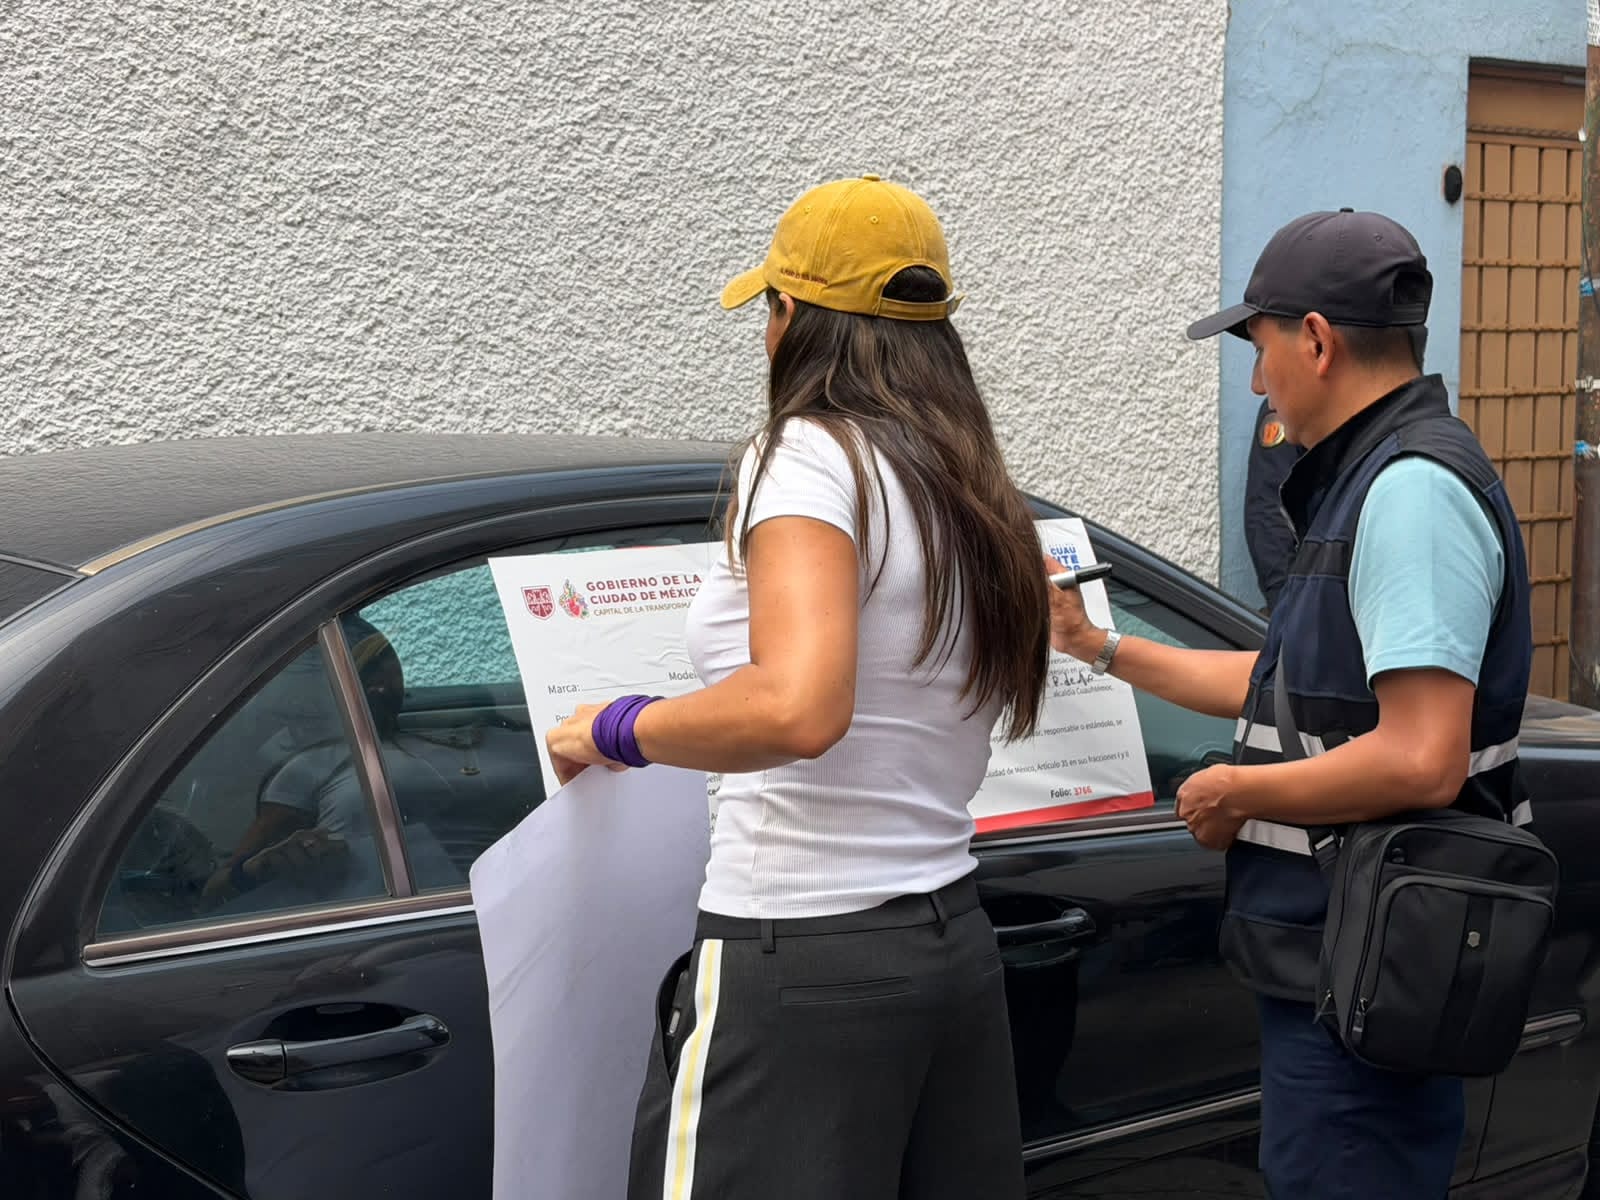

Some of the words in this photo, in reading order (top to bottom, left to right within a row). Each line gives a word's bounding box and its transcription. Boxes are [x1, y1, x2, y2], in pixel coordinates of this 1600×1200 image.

[1050, 546, 1076, 555] CUAU
[586, 577, 658, 592] GOBIERNO
[662, 575, 681, 586] DE
[684, 573, 702, 584] LA
[590, 592, 637, 605] CIUDAD
[640, 590, 657, 601] DE
[594, 607, 622, 617] CAPITAL
[623, 606, 634, 615] DE
[635, 605, 645, 613] LA
[548, 684, 581, 695] Marca:
[1044, 723, 1080, 736] responsable
[1069, 759, 1077, 767] en
[1051, 789, 1072, 798] Folio:
[1074, 785, 1093, 795] 3766
